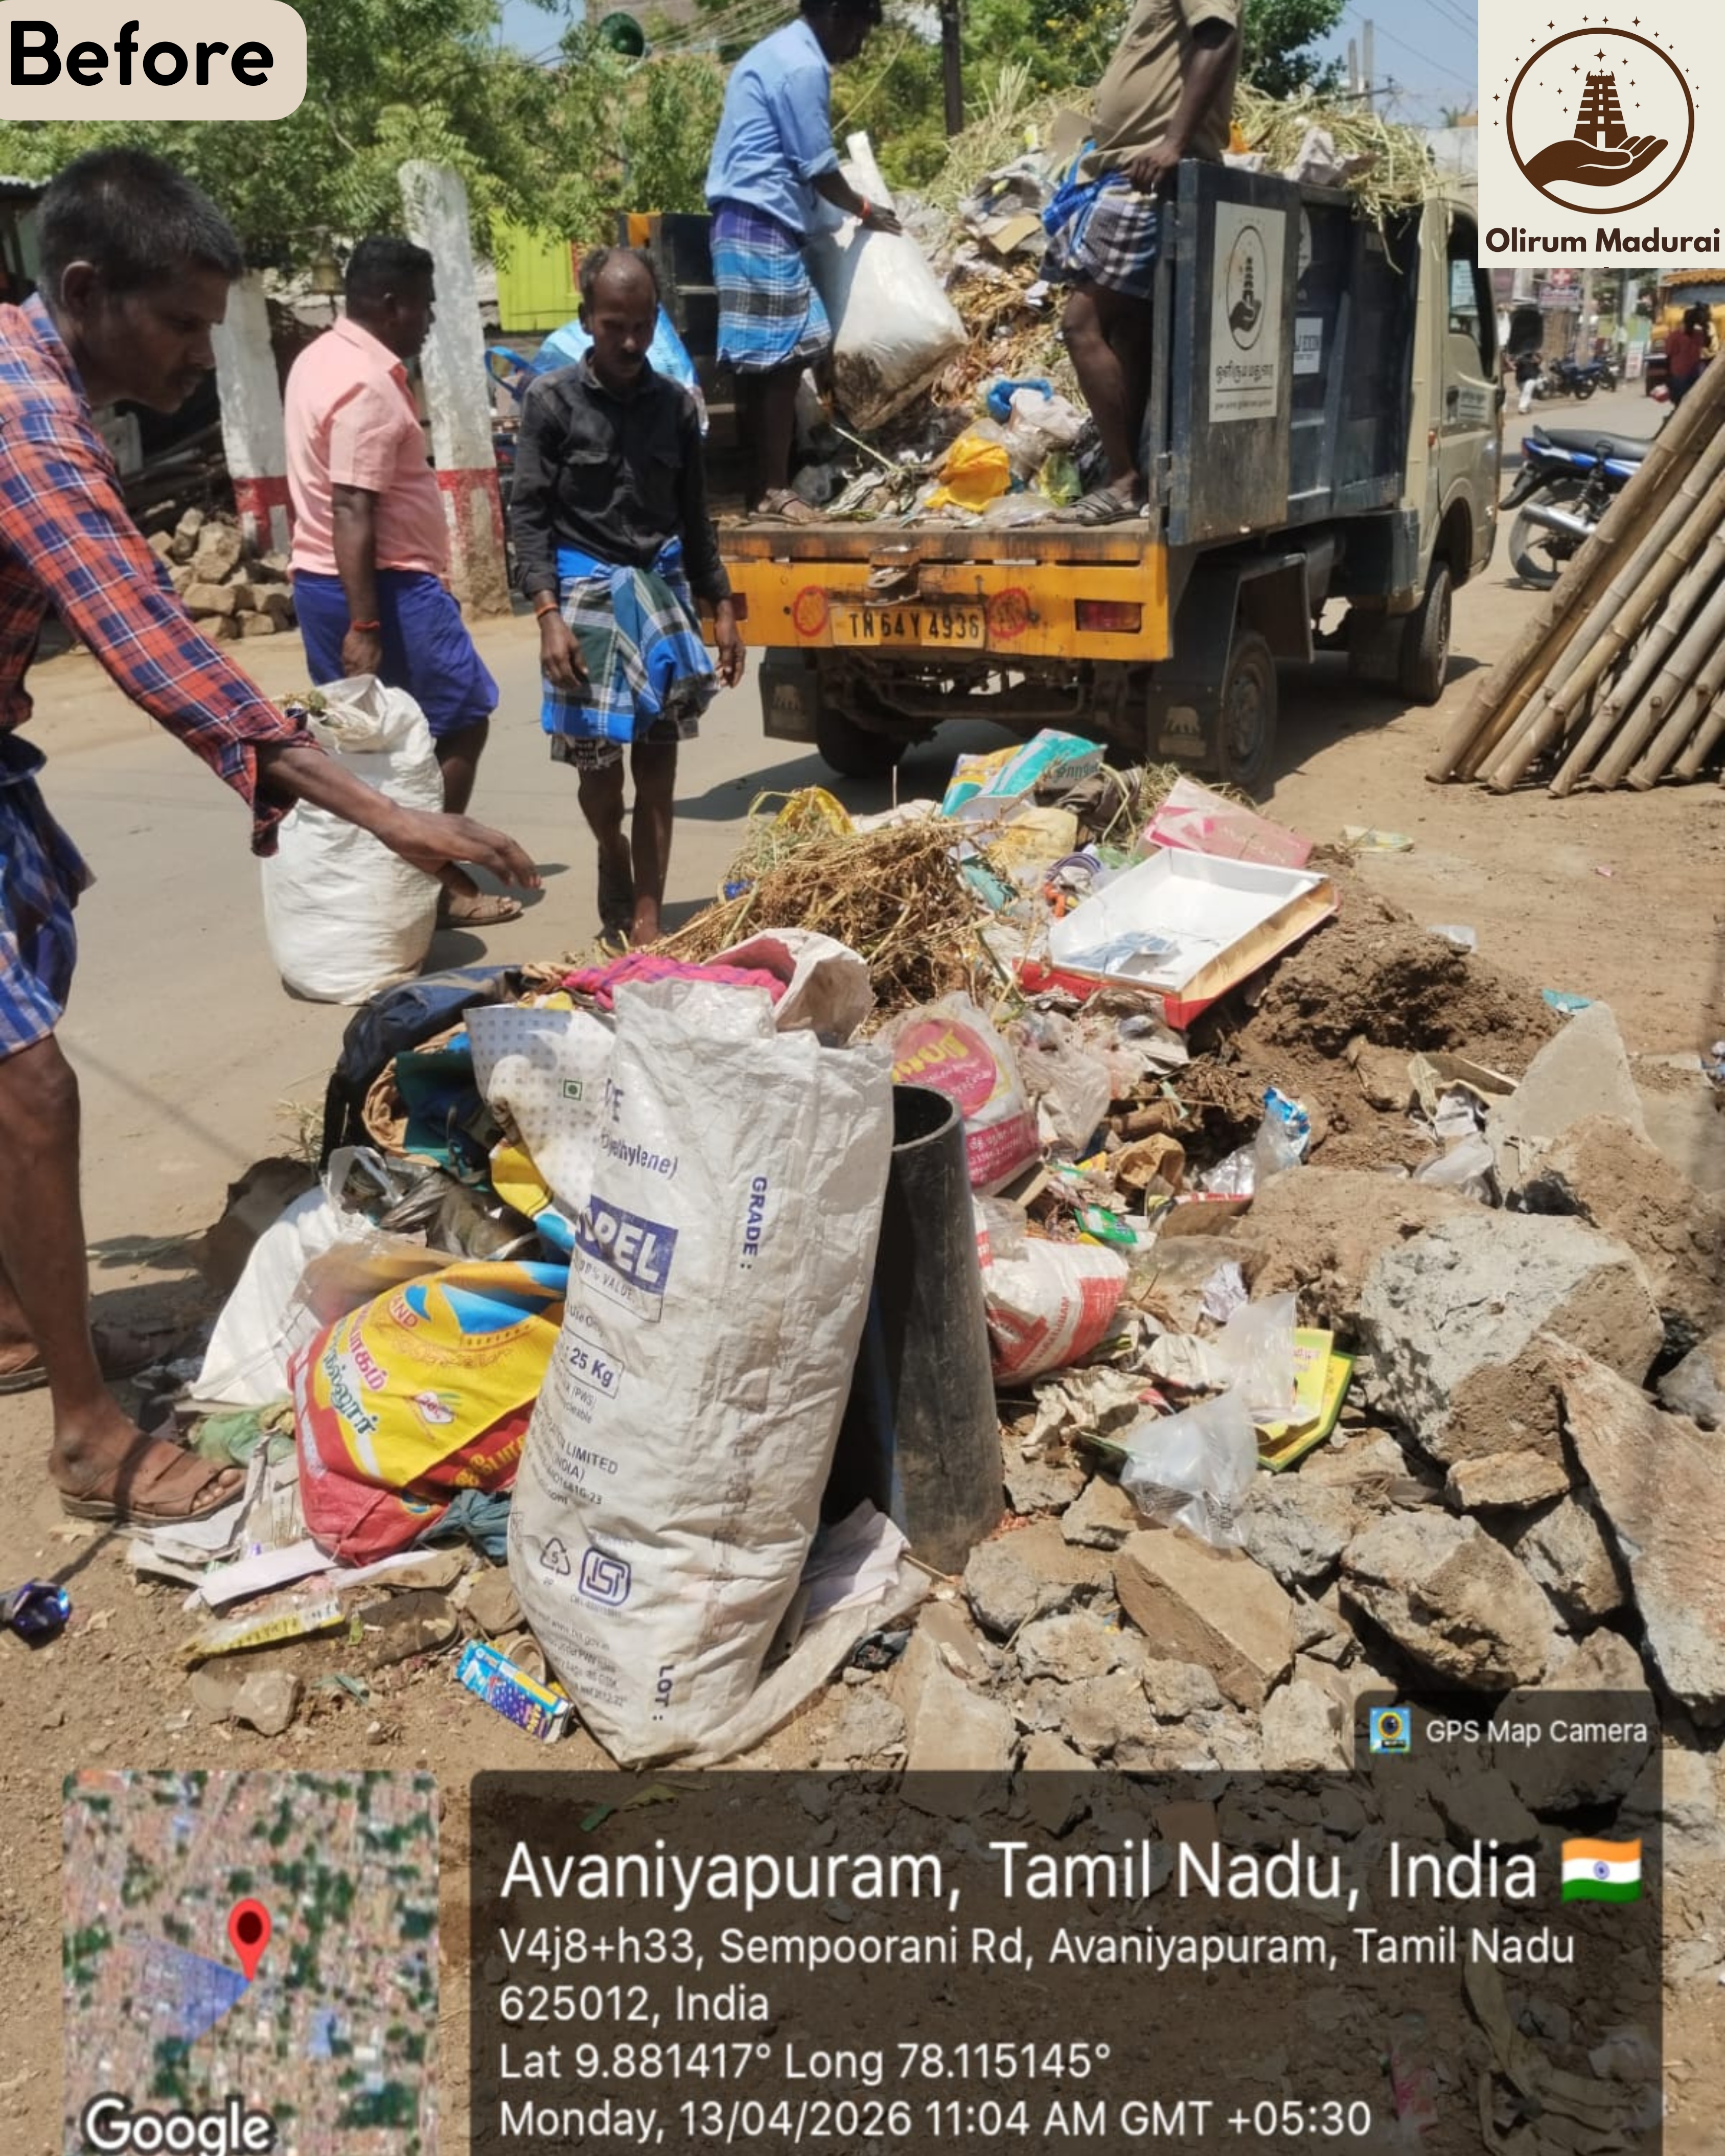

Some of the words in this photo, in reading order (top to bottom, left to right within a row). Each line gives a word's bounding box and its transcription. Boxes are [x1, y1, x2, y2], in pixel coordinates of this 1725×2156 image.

[849, 613, 873, 638] TN
[742, 1176, 768, 1257] GRADE
[569, 1347, 589, 1370] 25
[591, 1359, 614, 1388] Kg
[566, 1441, 618, 1475] LIMITED
[655, 1664, 675, 1707] LOT
